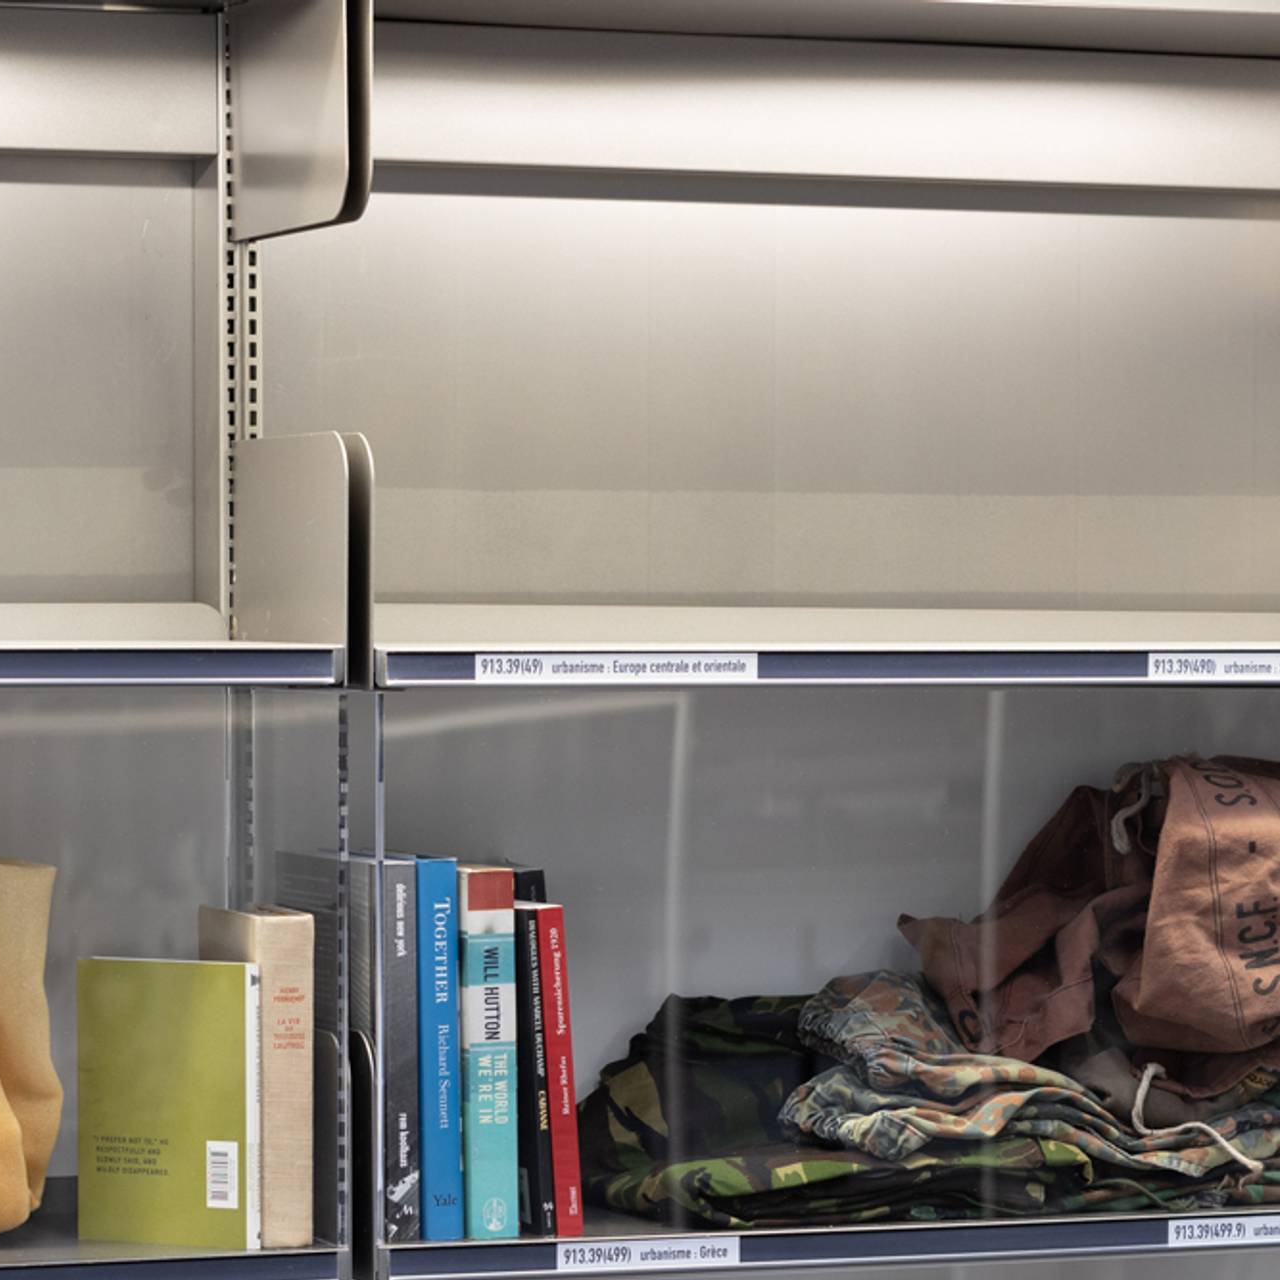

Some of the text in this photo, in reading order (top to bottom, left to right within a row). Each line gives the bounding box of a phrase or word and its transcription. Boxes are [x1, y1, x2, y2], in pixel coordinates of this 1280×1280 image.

[481, 659, 746, 676] 913.39(49) urbanisme Europe centrale et orientale
[1224, 660, 1270, 674] urbanisme
[550, 927, 558, 950] 1920
[433, 897, 451, 1003] TOGETHER
[532, 968, 540, 994] WITH
[484, 947, 500, 1040] WILL HUTTON
[438, 1025, 451, 1129] Richard Sennett
[494, 1054, 509, 1125] THE WORLD
[478, 1109, 493, 1125] IN
[433, 1194, 456, 1206] Yale
[1174, 1223, 1246, 1240] 913.39(499.9)
[564, 1244, 728, 1264] 913.39(499) urbanisme Grèce
